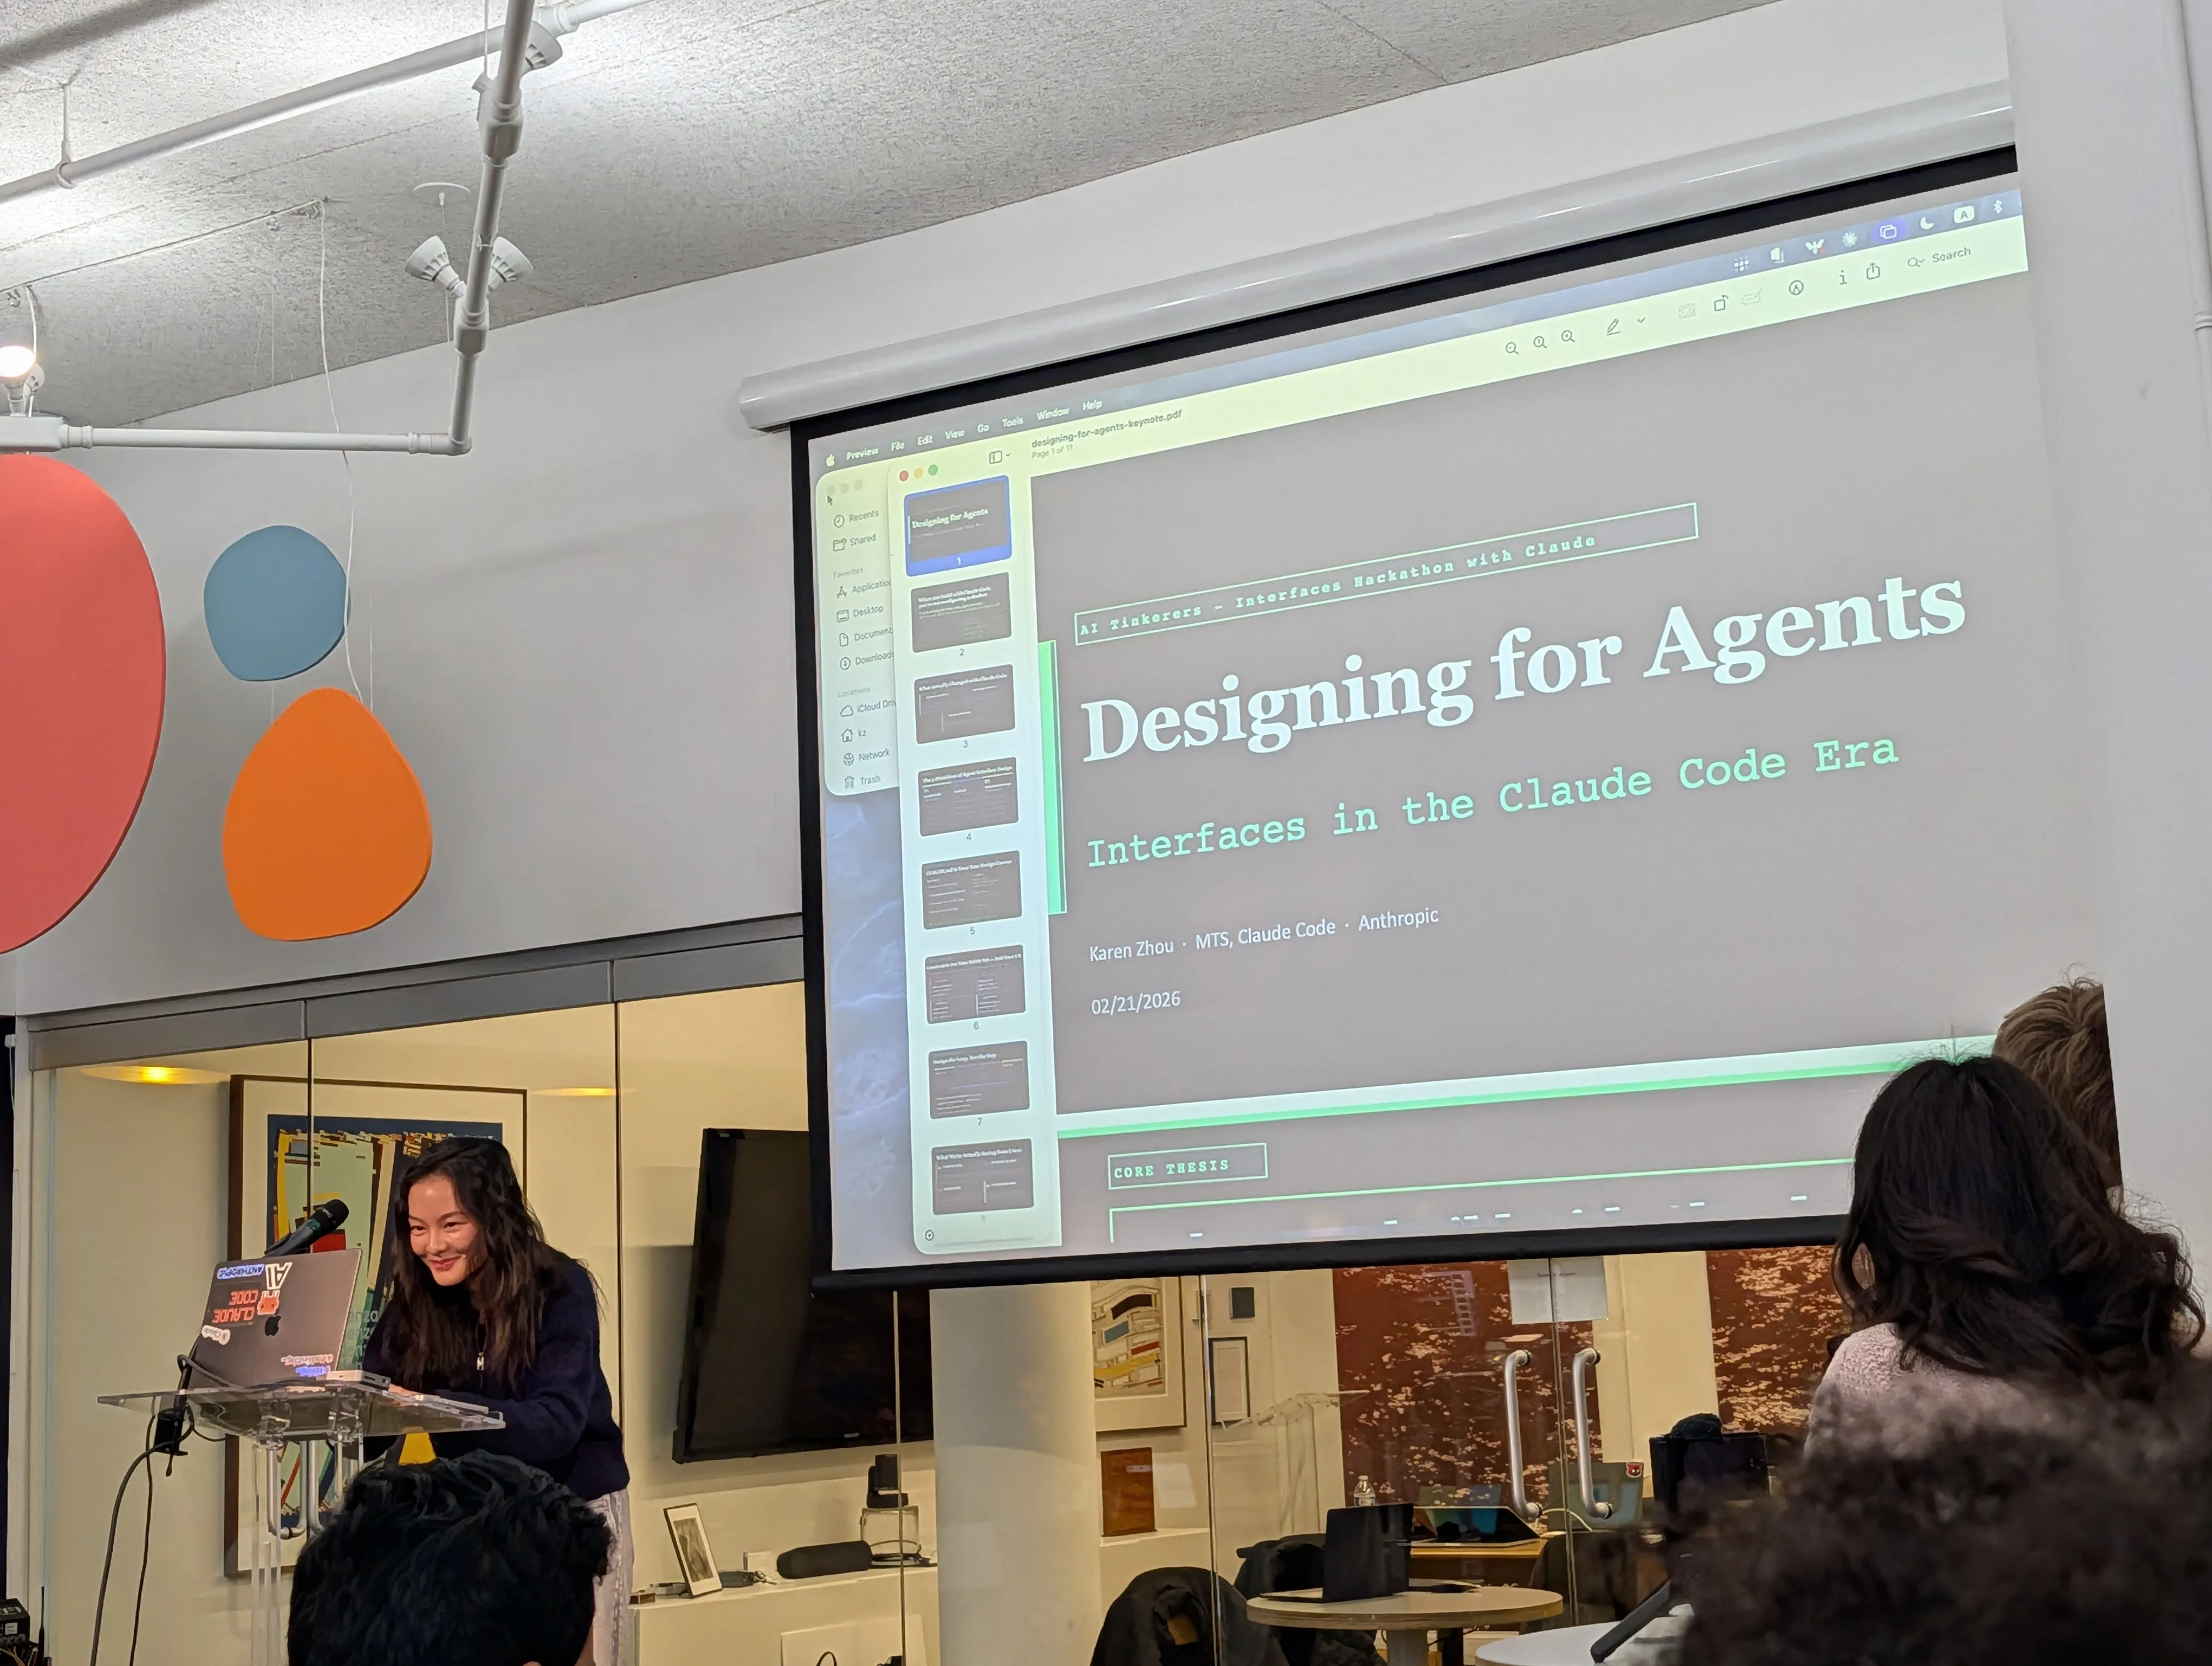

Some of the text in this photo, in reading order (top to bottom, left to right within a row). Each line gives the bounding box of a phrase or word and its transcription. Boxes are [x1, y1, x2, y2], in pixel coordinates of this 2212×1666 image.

[1932, 247, 1971, 262] Search
[847, 400, 1102, 460] Preview File Edit View Go Tools Window Help
[1032, 409, 1182, 448] designing-for-agents-keynote.pdf
[1032, 449, 1050, 459] Page
[849, 510, 879, 522] Recents
[850, 534, 877, 546] Shared
[956, 557, 962, 565] 1
[1081, 623, 1098, 636] AI
[1110, 605, 1202, 630] Tinkerers
[1236, 580, 1341, 608] Interfaces
[1354, 561, 1454, 588] Hackathon
[1467, 549, 1512, 568] with
[1526, 535, 1596, 558] Claude
[853, 605, 884, 617] Desktop
[1081, 576, 1966, 762] Designing for Agents
[963, 740, 968, 748] 3
[859, 748, 890, 761] Network
[860, 774, 880, 785] Trash
[1088, 738, 1899, 867] Interfaces in the Claude Code Era
[1090, 943, 1132, 962] Karen
[1136, 939, 1174, 957] Zhou
[1195, 932, 1234, 950] MTS,
[1237, 924, 1291, 945] Claude
[1295, 918, 1336, 938] Code
[1358, 907, 1439, 932] Anthropic
[1091, 990, 1181, 1015] 02/21/2026
[973, 1021, 979, 1030] 6
[978, 1118, 982, 1126] 7
[1114, 1159, 1229, 1179] CORE THESIS
[229, 1290, 259, 1305] CODE
[212, 1306, 254, 1323] CLAUDE
